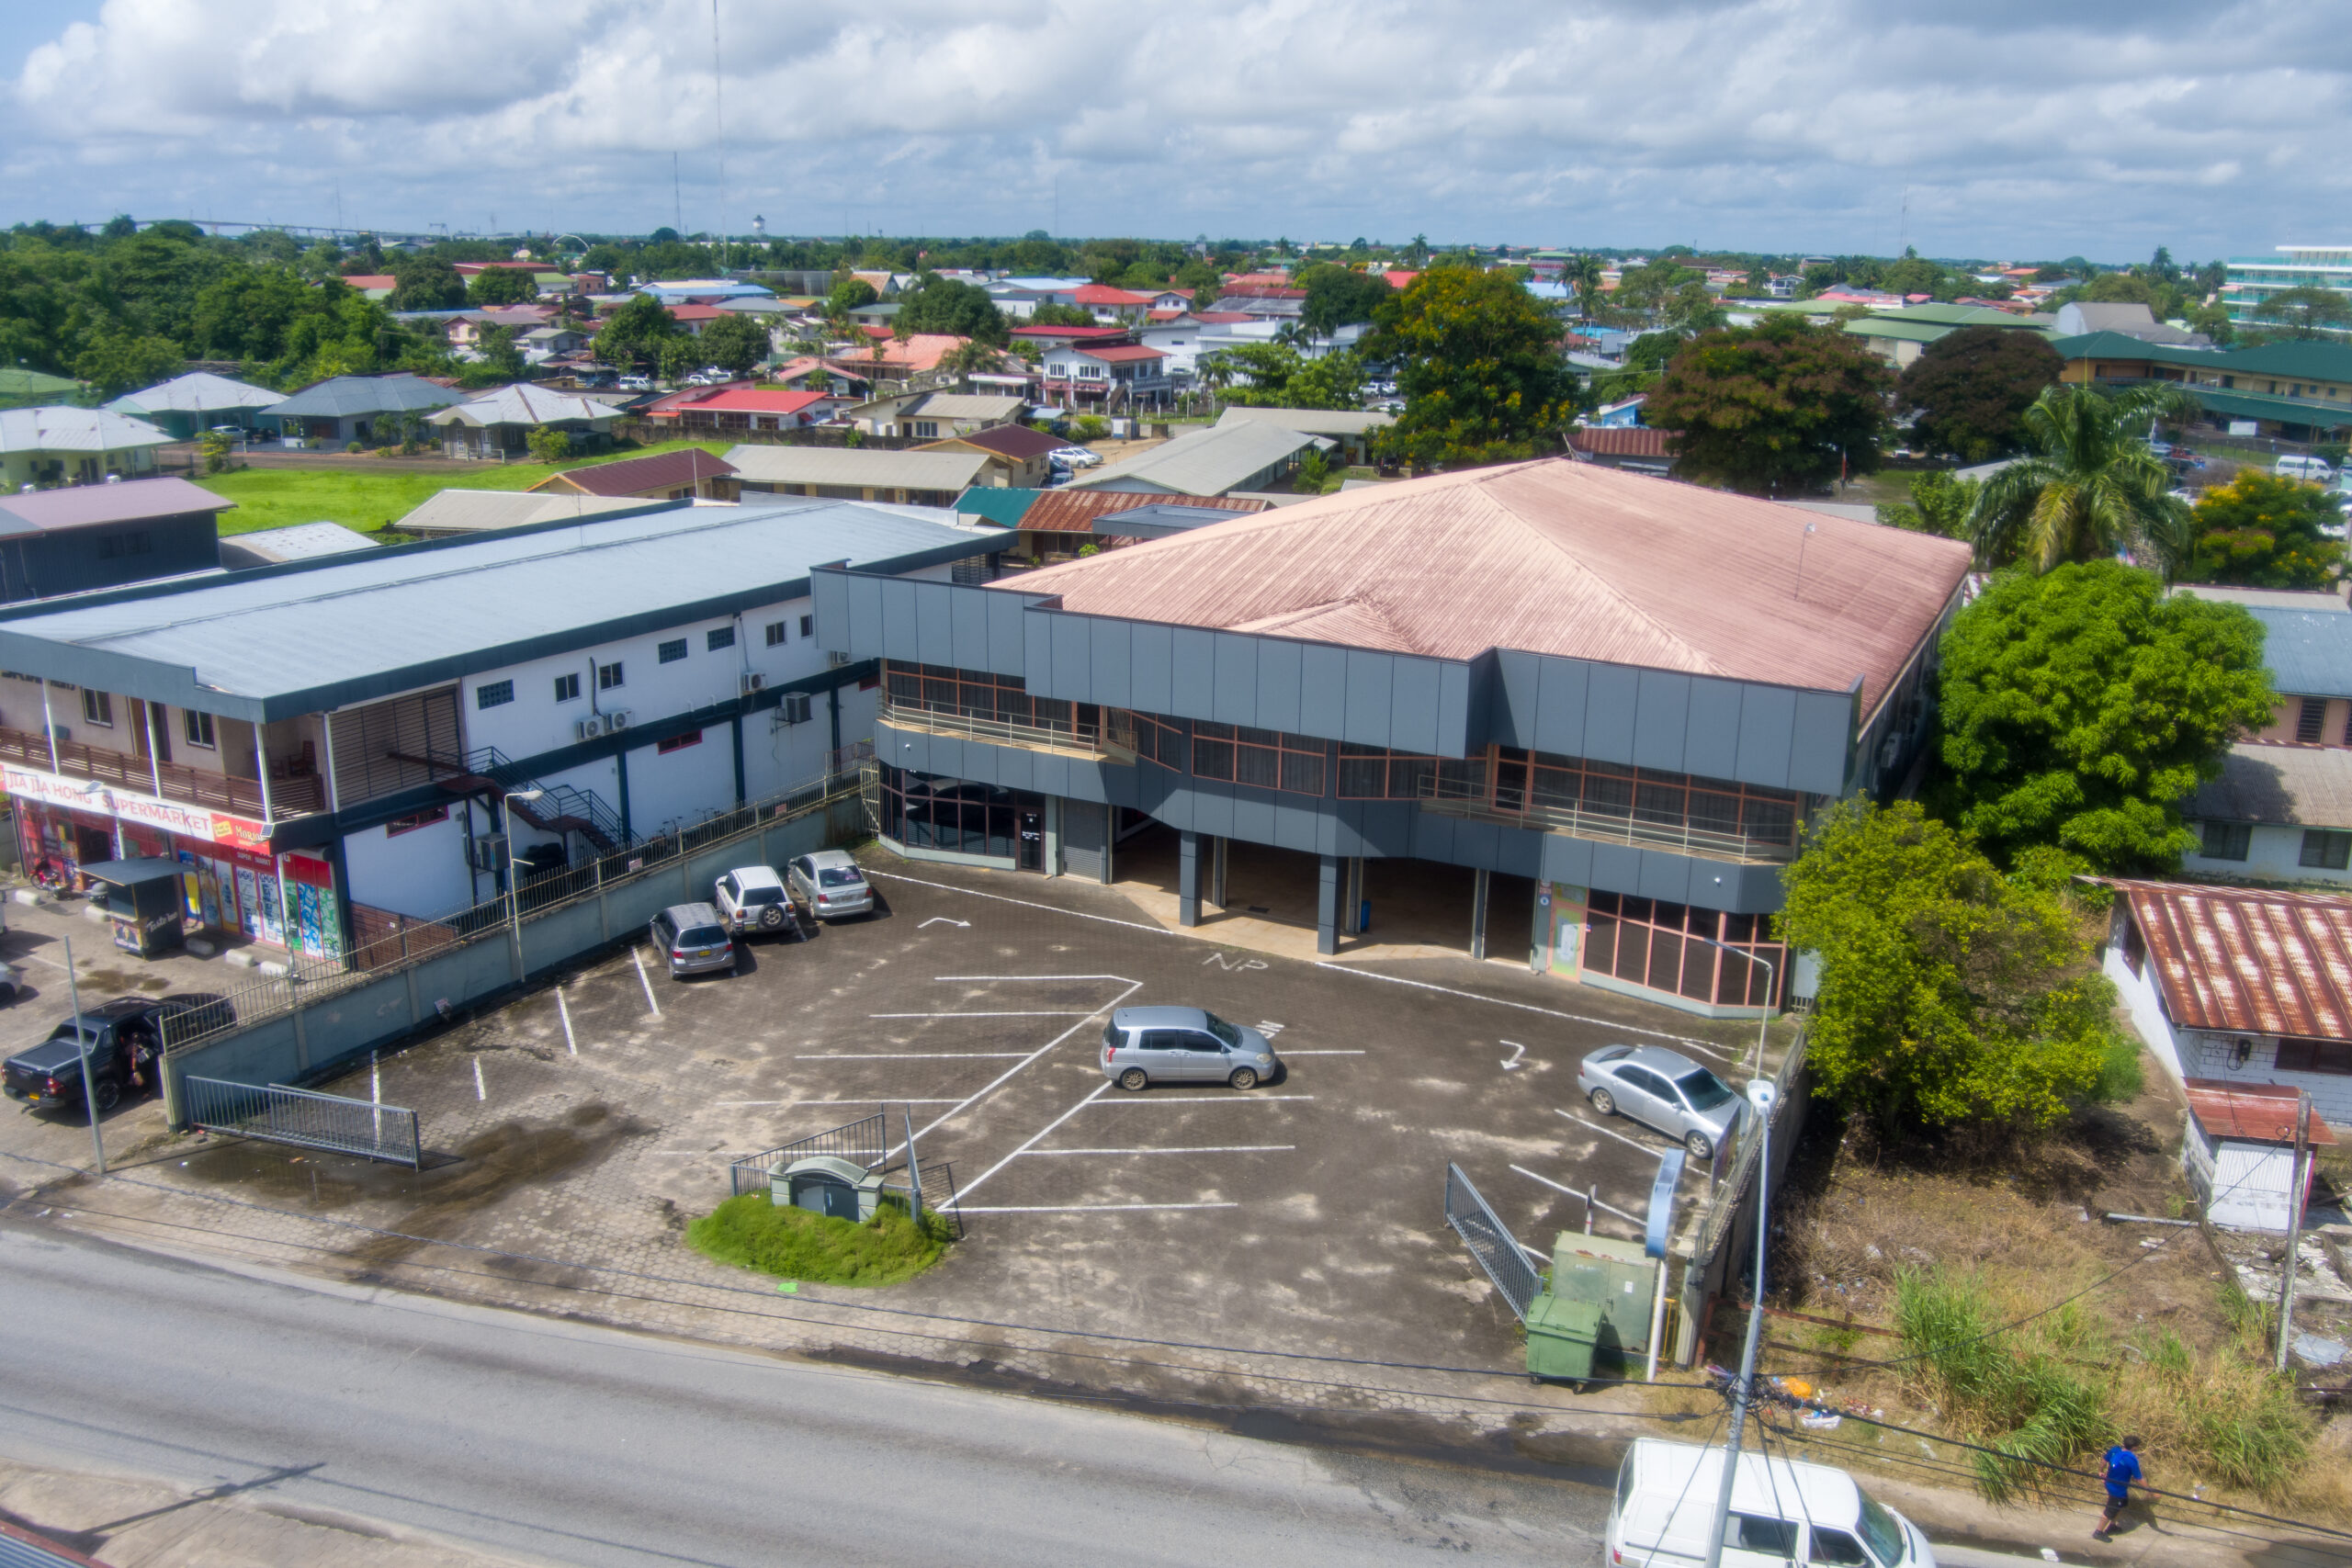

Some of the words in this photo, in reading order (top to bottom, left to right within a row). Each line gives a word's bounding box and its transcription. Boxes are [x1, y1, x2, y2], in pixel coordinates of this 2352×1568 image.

[8, 773, 28, 789] JIA
[31, 778, 51, 795] JIA
[51, 785, 92, 805] HONG
[101, 794, 209, 832] SUPERMARKET
[1202, 952, 1269, 972] NP
